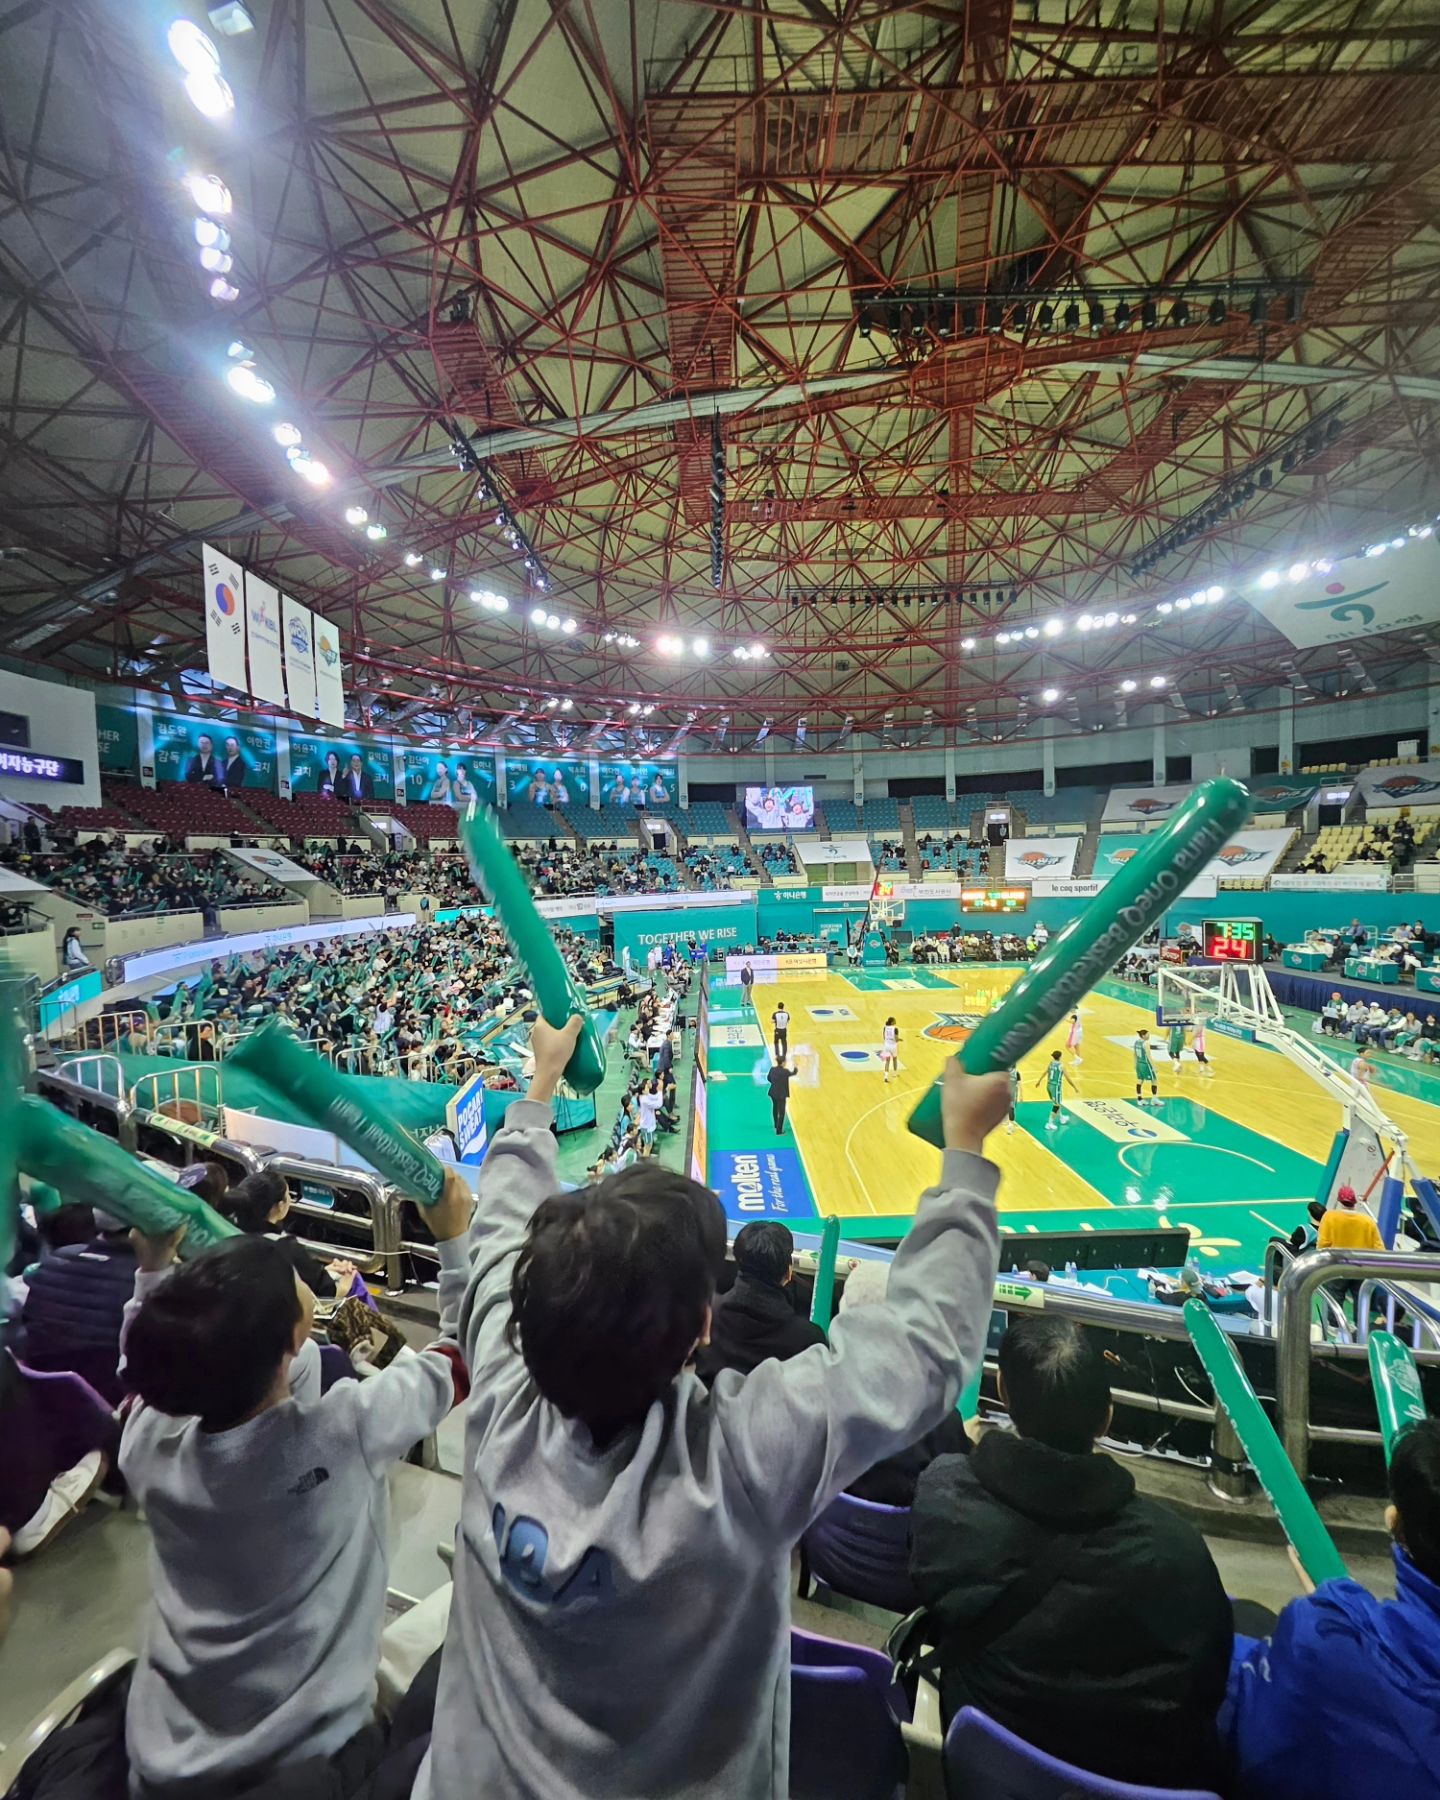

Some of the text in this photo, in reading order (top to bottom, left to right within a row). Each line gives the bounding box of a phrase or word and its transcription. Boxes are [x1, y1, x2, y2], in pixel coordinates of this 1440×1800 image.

[159, 750, 180, 764] 감독
[410, 774, 423, 785] 10
[510, 780, 515, 790] 3
[643, 783, 648, 792] 2
[670, 783, 675, 792] 5
[1173, 818, 1226, 873] Hana
[783, 891, 807, 899] 하나은행
[1074, 884, 1098, 893] sportif
[1117, 869, 1179, 927] OneQ
[638, 927, 738, 946] TOGETHER WE RISE
[1217, 922, 1254, 940] 7:35
[1213, 936, 1247, 958] 24
[1040, 924, 1129, 1014] Basketball
[458, 1087, 483, 1127] POCARI
[459, 1104, 482, 1151] SWEAT
[363, 1123, 417, 1176] Basketball
[731, 1154, 766, 1212] molten
[771, 1199, 789, 1213] For
